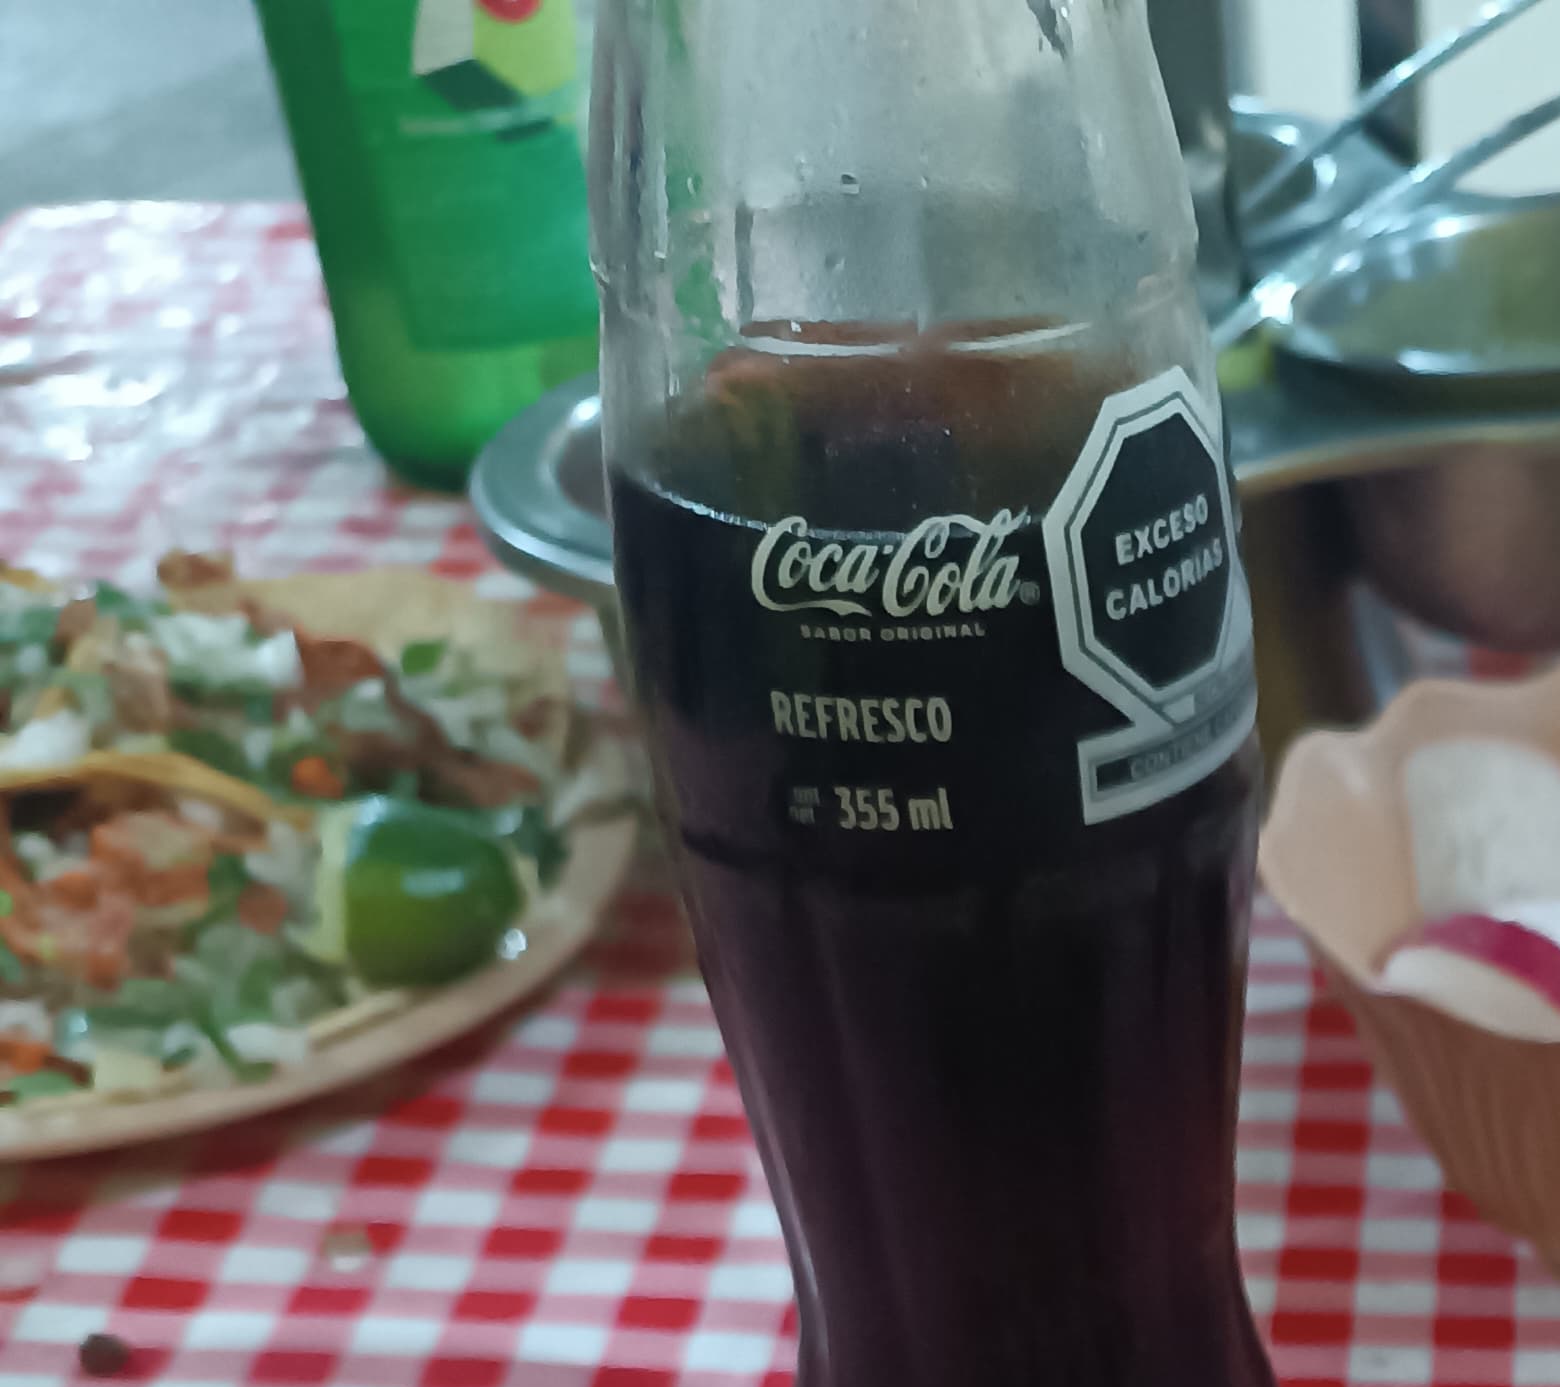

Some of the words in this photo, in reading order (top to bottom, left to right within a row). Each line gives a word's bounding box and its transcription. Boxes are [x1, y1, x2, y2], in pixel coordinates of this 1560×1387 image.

[1115, 493, 1208, 566] EXCESO
[751, 509, 1030, 617] Coca-Cola
[1106, 537, 1223, 621] CALORIAS
[801, 624, 872, 641] SABOR
[880, 622, 985, 641] ORIGINAL
[770, 690, 952, 743] REFRESCO
[834, 786, 900, 831] 355
[908, 787, 954, 831] ml
